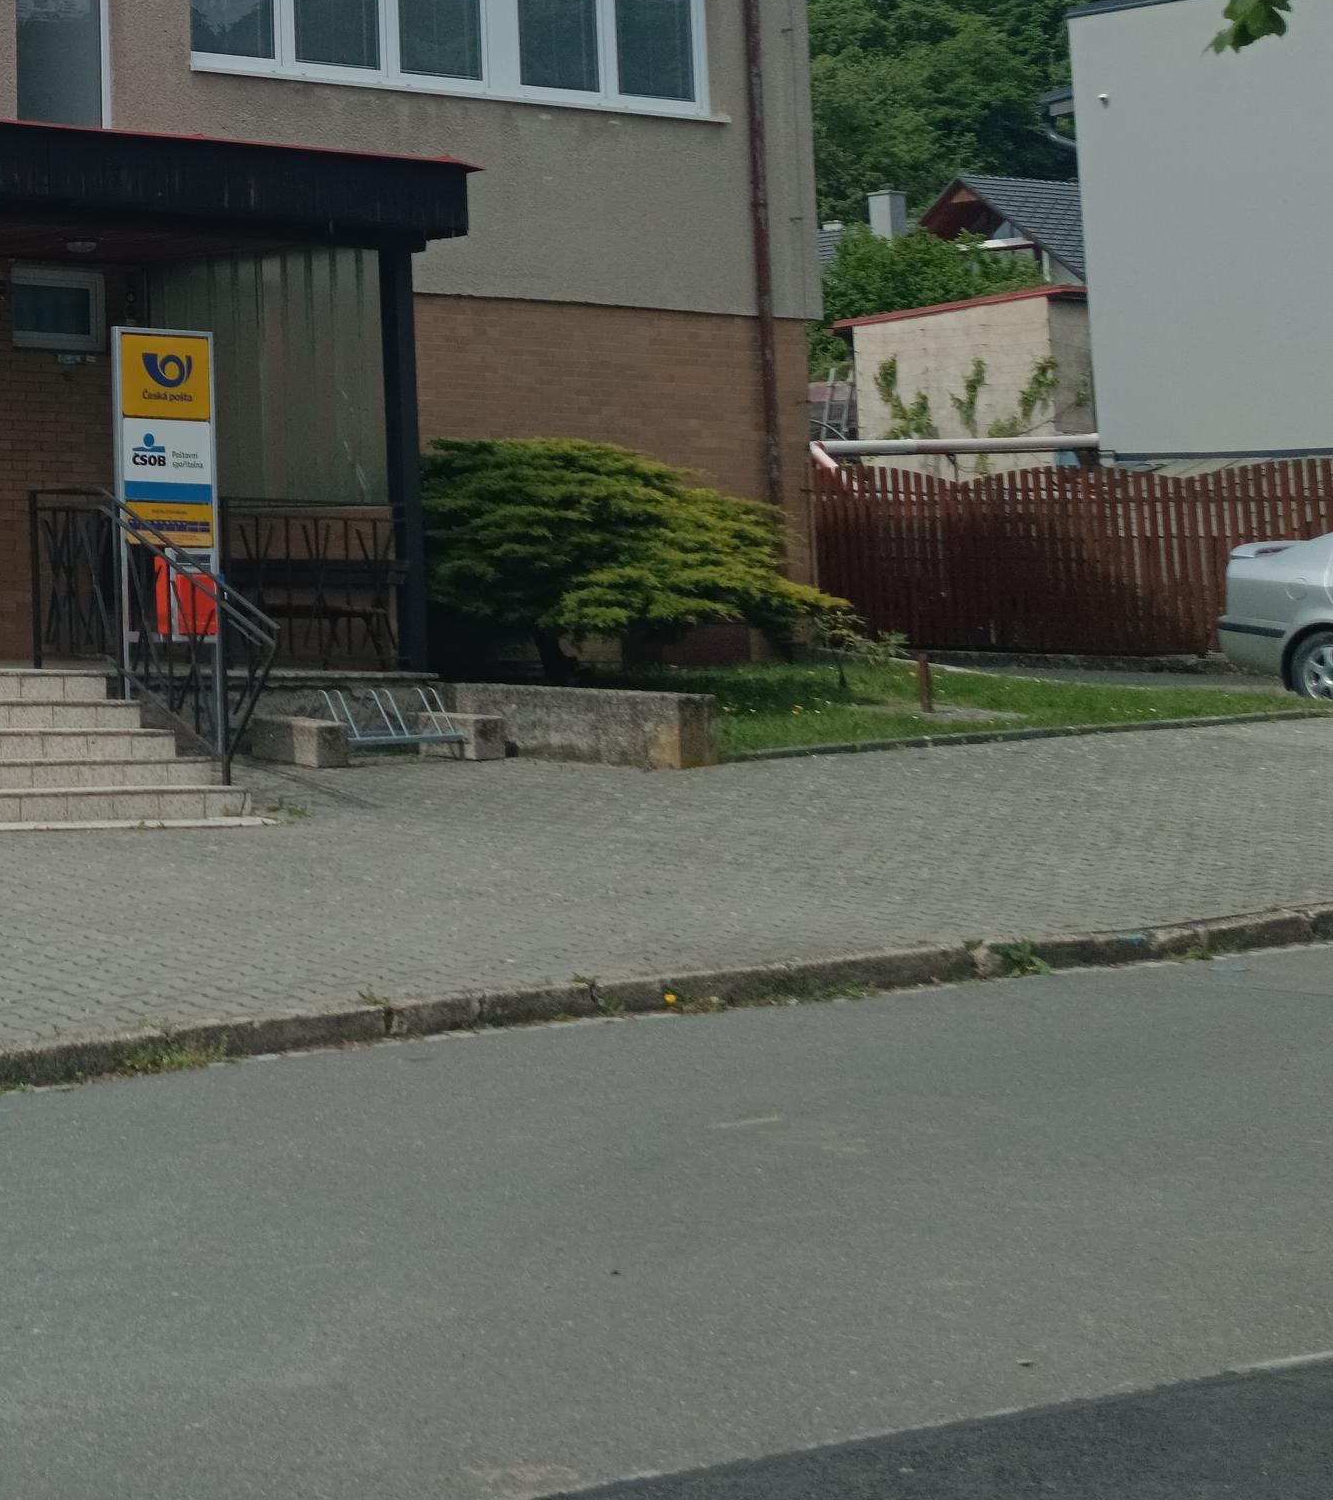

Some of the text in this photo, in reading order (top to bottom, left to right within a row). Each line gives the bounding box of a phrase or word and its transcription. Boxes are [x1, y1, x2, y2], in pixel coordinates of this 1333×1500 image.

[142, 388, 193, 402] Česká pošta
[132, 452, 166, 466] ČSOB
